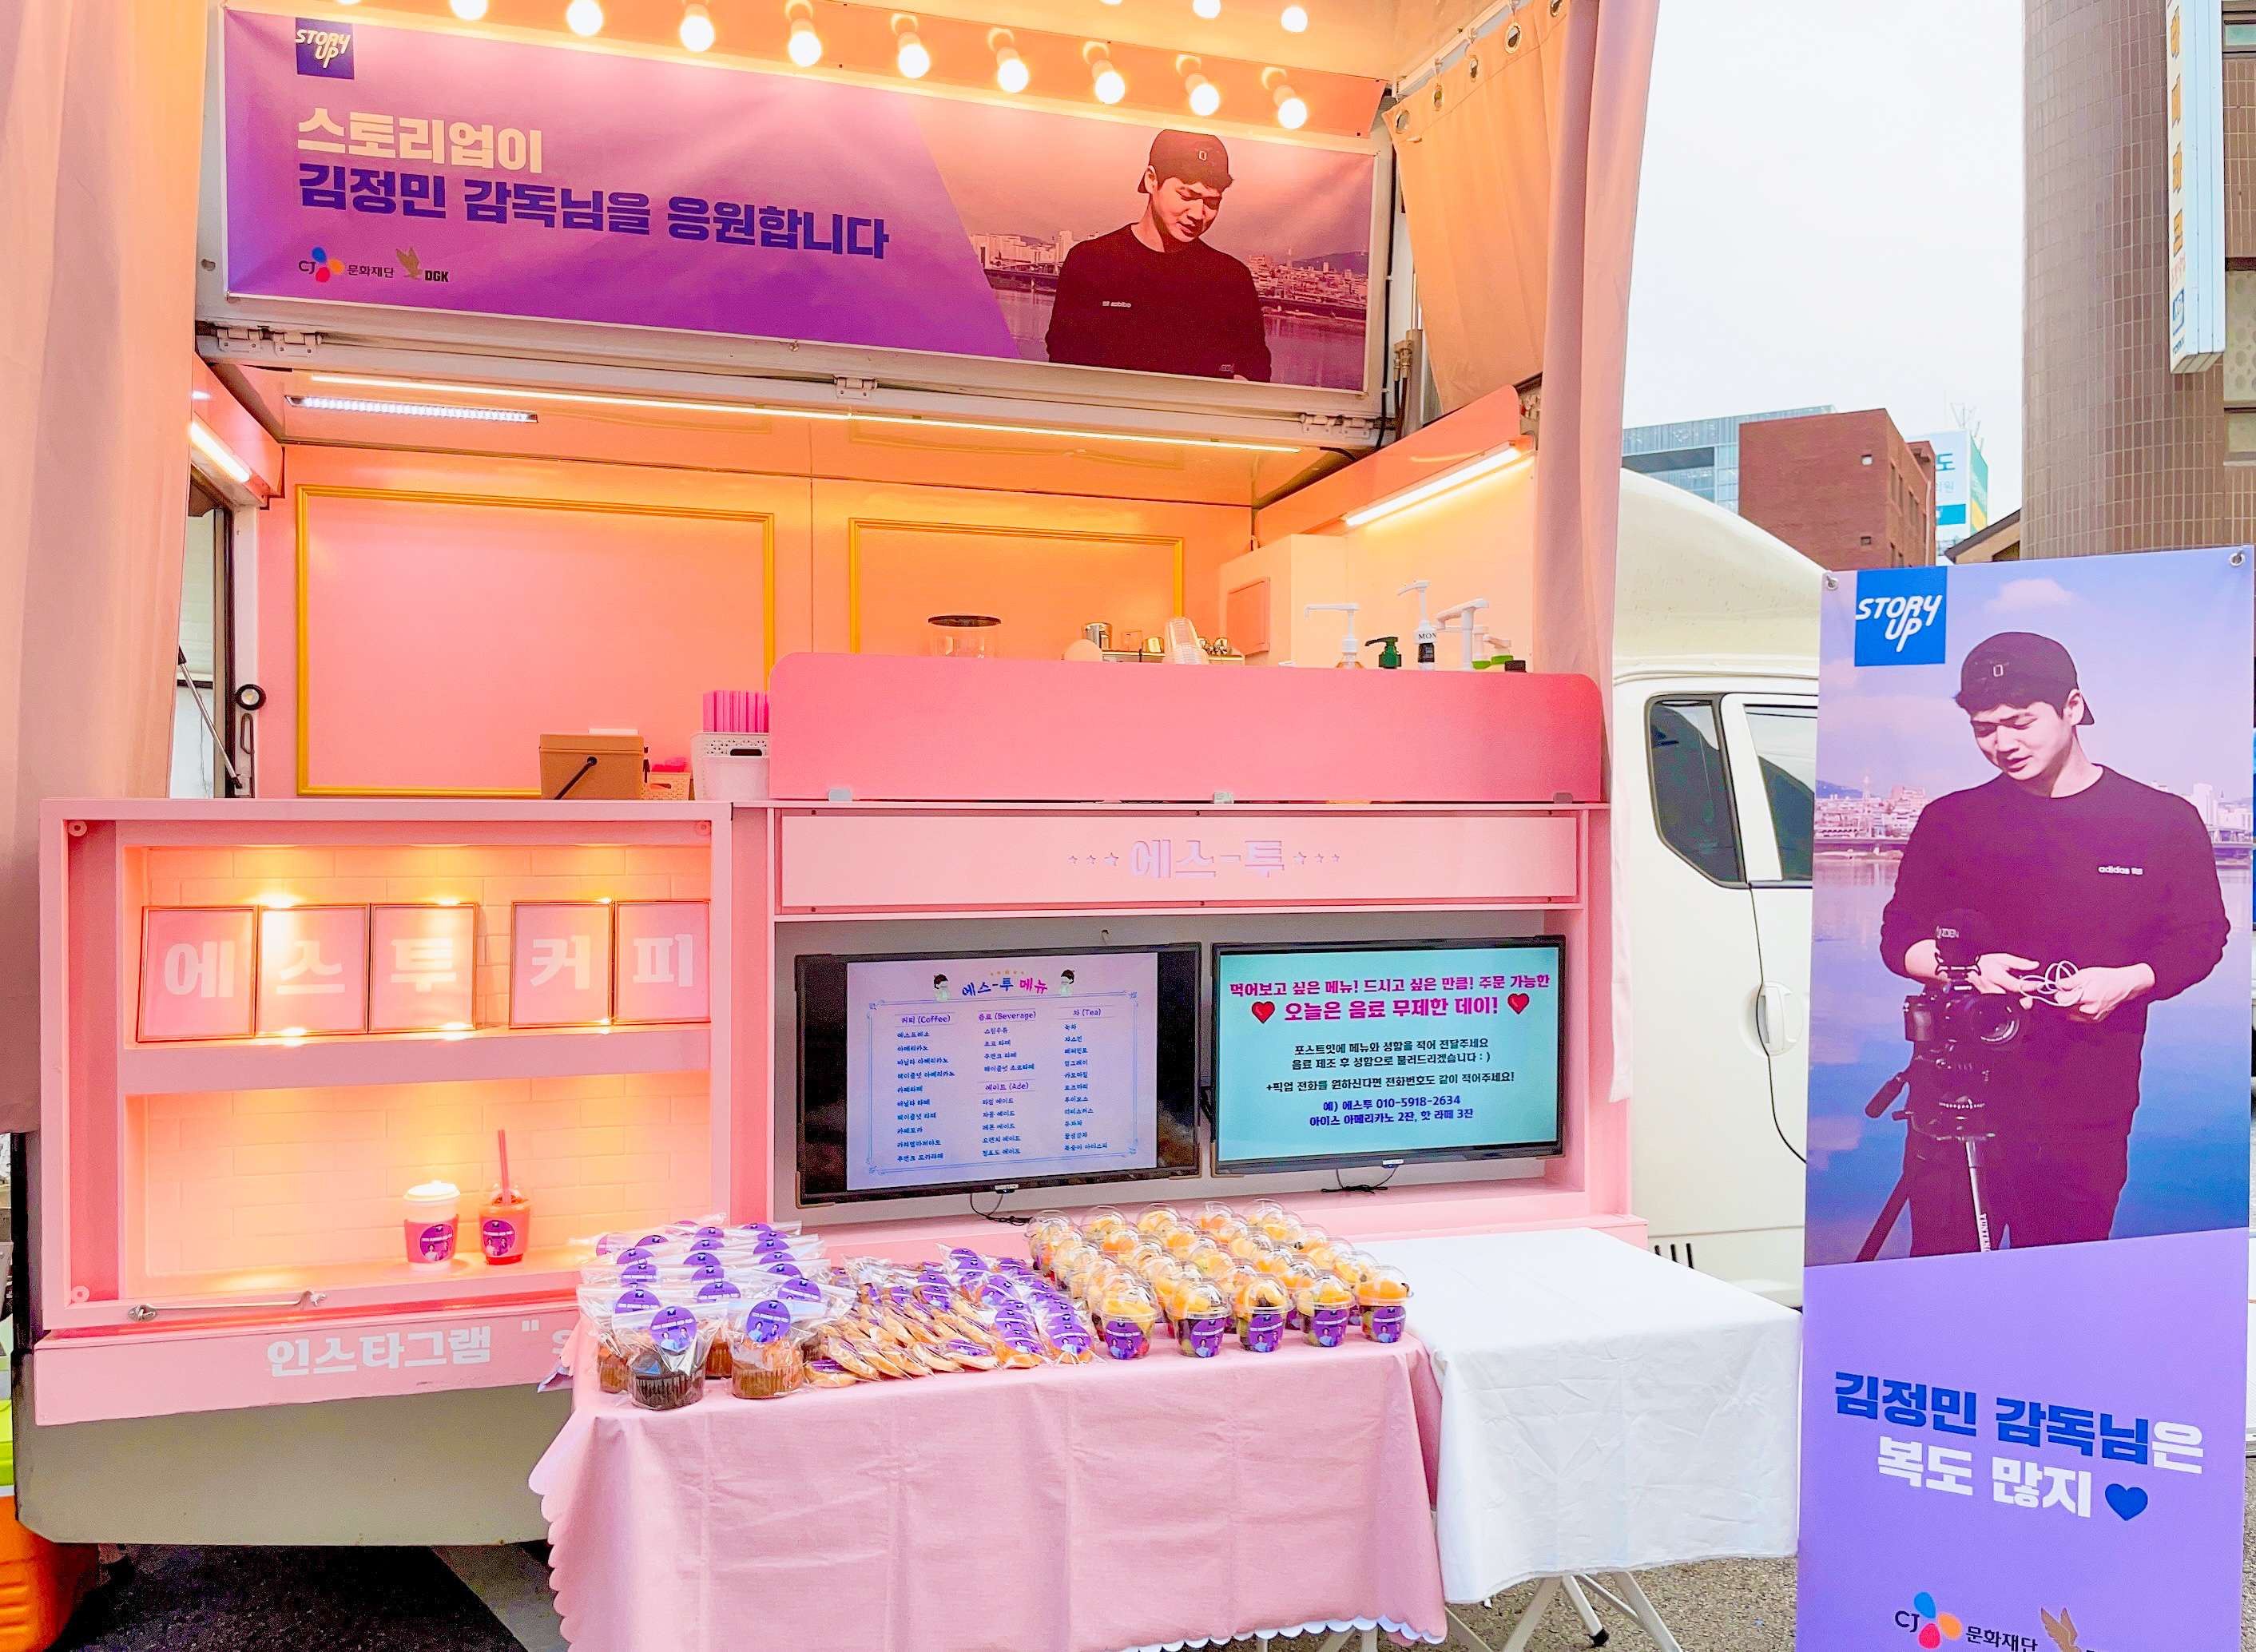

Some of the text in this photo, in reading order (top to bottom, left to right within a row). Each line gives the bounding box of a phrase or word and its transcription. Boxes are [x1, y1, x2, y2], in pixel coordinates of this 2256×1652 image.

[295, 29, 351, 54] STORY
[315, 45, 339, 69] UP
[297, 107, 542, 173] 스토리업이
[299, 163, 890, 260] 김정민 감독님을 응원합니다
[298, 260, 316, 275] CJ
[347, 264, 395, 278] 문화재단
[425, 270, 449, 282] DGK
[1856, 594, 1943, 626] STORY
[1885, 618, 1922, 653] UP
[1130, 840, 1285, 879] 에스-투
[165, 934, 694, 999] 에스투 커피
[962, 977, 1048, 996] 에스-투 메뉴
[1230, 974, 1550, 997] 먹어보고 싶은 메뉴! 드시고 싶은 만큼! 주문 가능한
[917, 1015, 951, 1023] (Coffee)
[995, 1011, 1036, 1020] (Beverage)
[1285, 996, 1498, 1021] 오늘은 음료 무제한 데이!
[1294, 1038, 1488, 1055] 포스트잇에 메뉴와 성함을 적어 전달주세요
[1292, 1059, 1313, 1070] 음료
[1316, 1058, 1337, 1069] 제조
[1340, 1057, 1349, 1068] 후
[1353, 1056, 1393, 1067] 성함으로
[1396, 1052, 1476, 1066] 불러드리겠습니다
[1266, 1071, 1515, 1092] +픽업 전화를 원하신다면 전화번호도 같이 적어주세요!
[1323, 1095, 1461, 1112] 예) 에스투 010-5918-2634
[1309, 1116, 1340, 1126] 아이스
[1344, 1113, 1394, 1125] 아메리카노
[1420, 1110, 1431, 1121] 핫
[1457, 1108, 1473, 1118] 3잔
[267, 1325, 491, 1377] 인스타그램
[1835, 1371, 2204, 1474] 김정민 감독님은
[1877, 1436, 2091, 1519] 복도 많지
[1894, 1610, 1920, 1633] CJ
[1965, 1626, 2039, 1652] 문화재단
